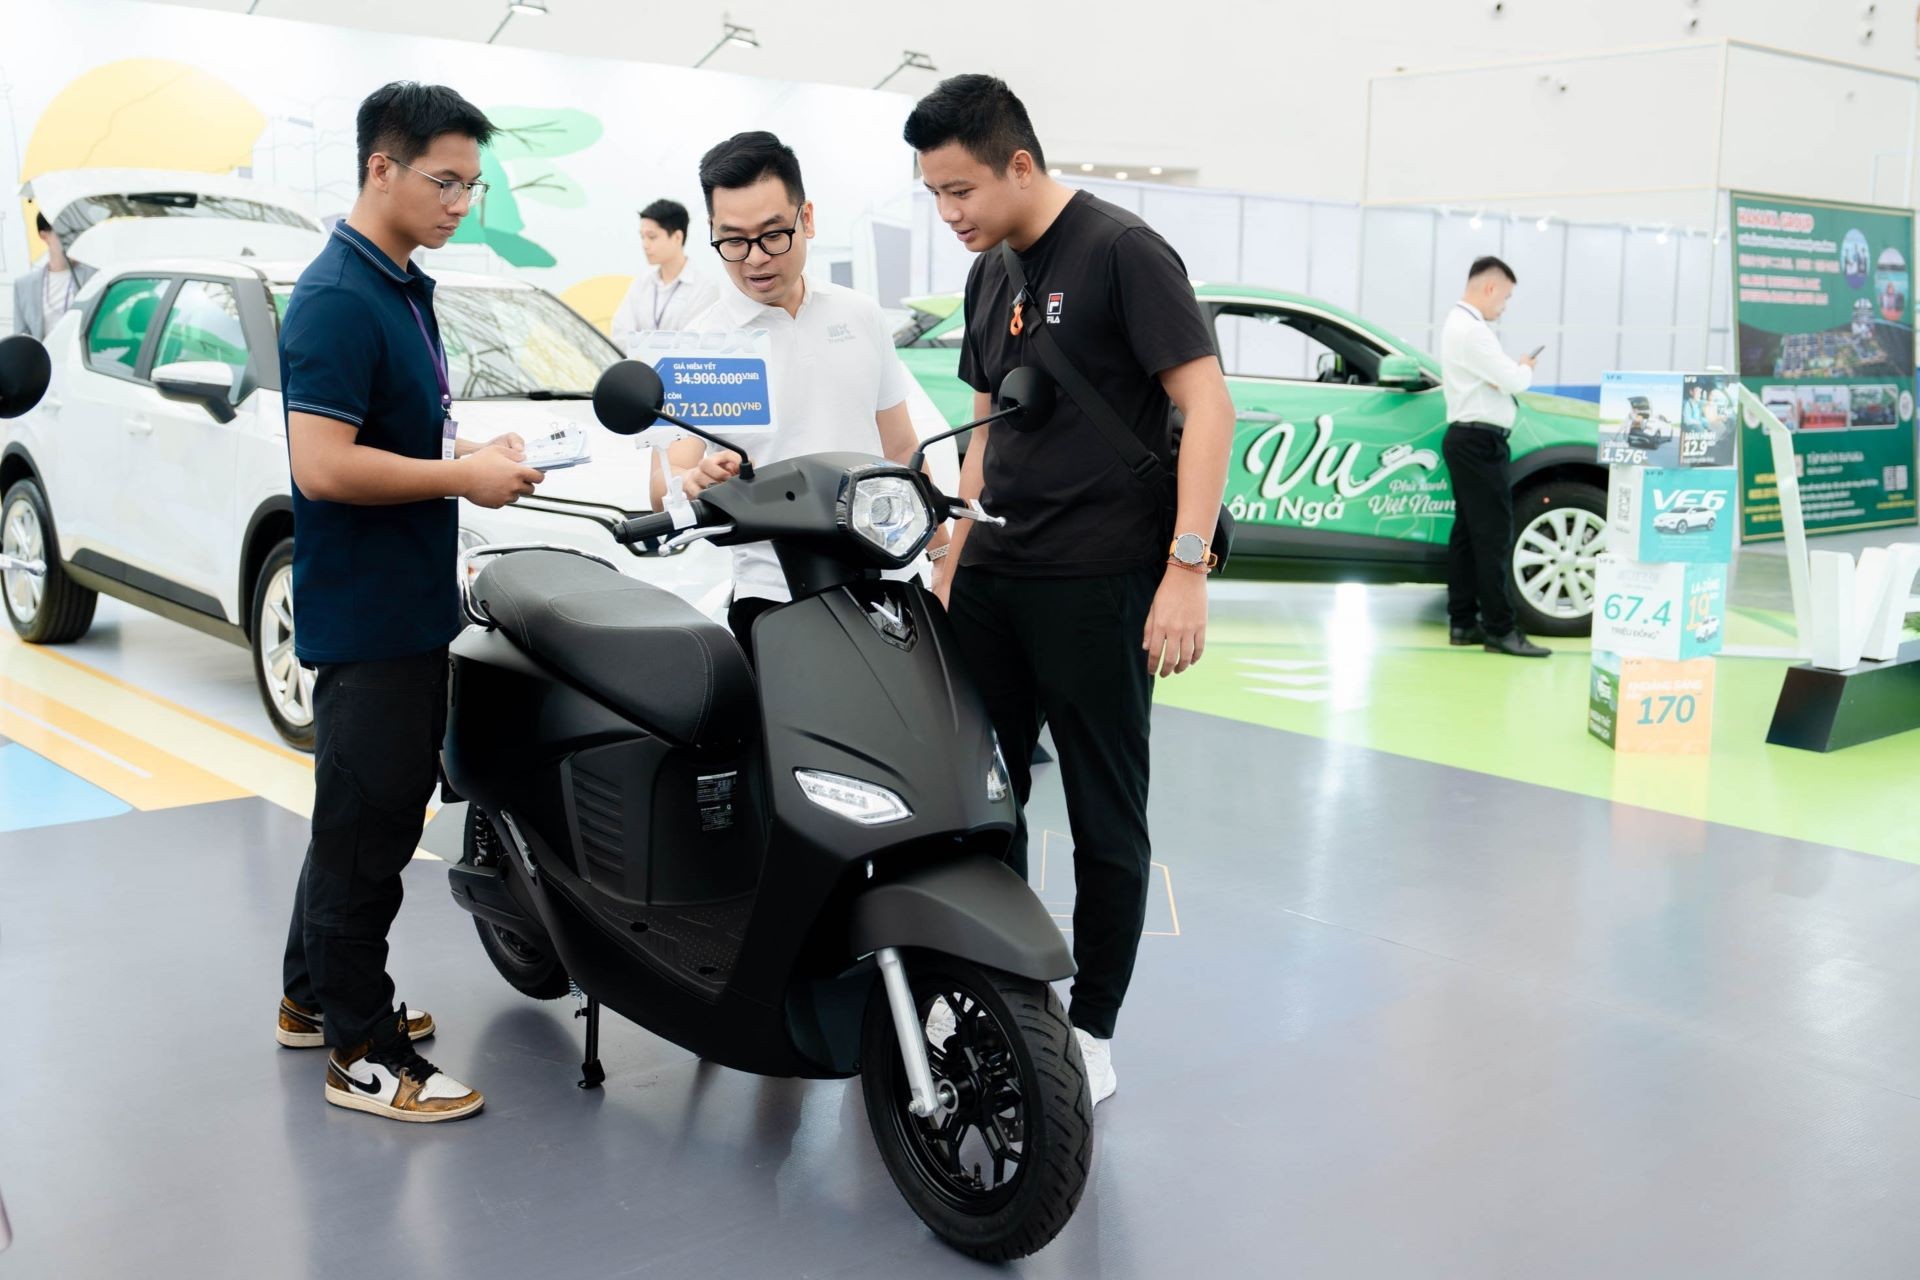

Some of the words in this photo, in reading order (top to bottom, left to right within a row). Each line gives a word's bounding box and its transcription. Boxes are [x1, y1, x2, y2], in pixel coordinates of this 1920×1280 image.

[1046, 316, 1060, 324] FILA
[1223, 494, 1267, 520] ôn
[1276, 494, 1346, 528] Ngả
[1368, 494, 1408, 515] Việt
[1409, 494, 1456, 513] Nam
[1604, 593, 1672, 627] 67.4
[1637, 694, 1696, 725] 170
